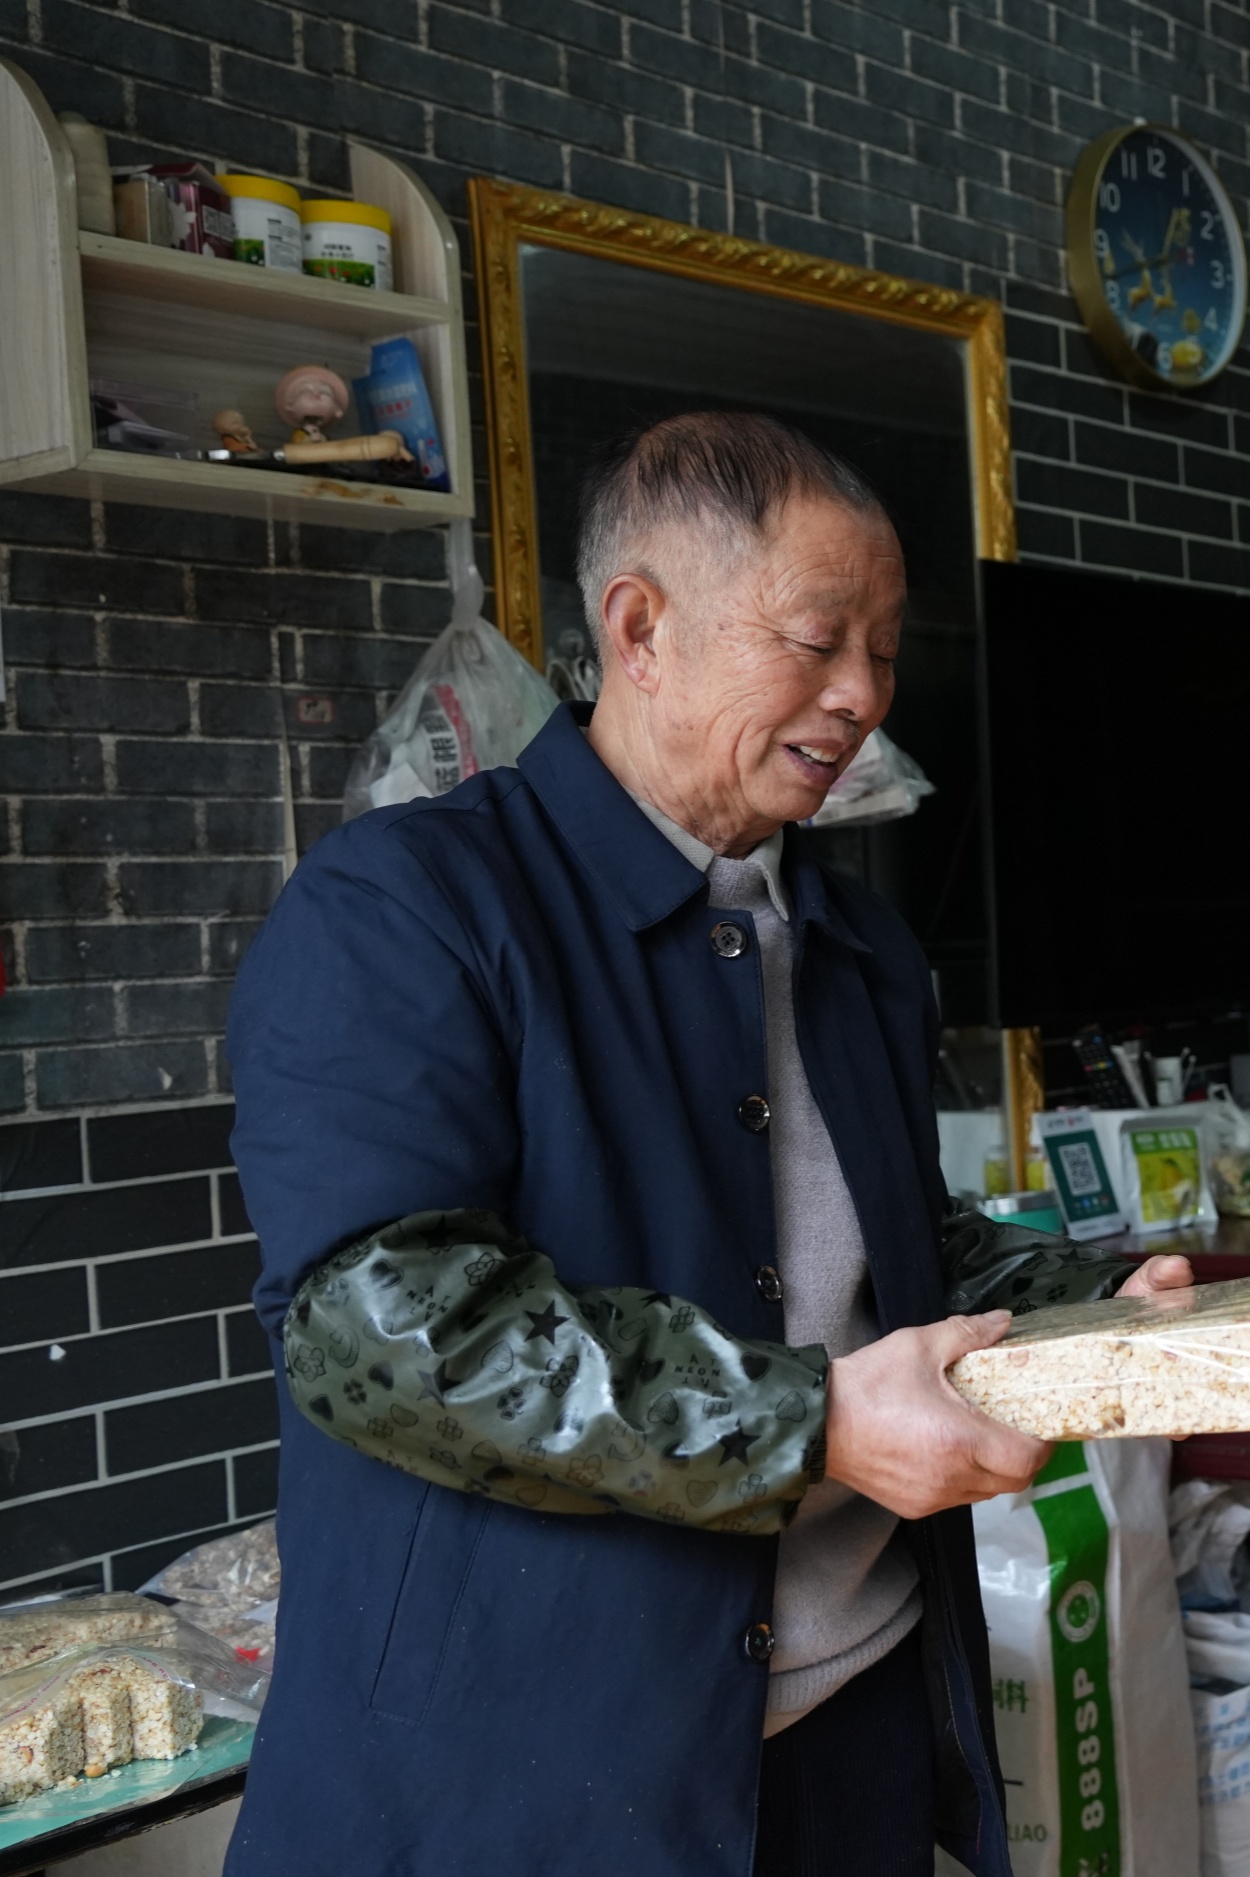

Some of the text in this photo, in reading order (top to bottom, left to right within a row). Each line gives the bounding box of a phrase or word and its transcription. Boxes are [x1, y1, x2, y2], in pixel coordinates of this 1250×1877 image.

[1120, 148, 1137, 181] 11
[1147, 145, 1167, 179] 12
[1099, 181, 1121, 214] 10
[1181, 167, 1190, 198] 1
[1200, 210, 1214, 241] 2
[1094, 227, 1111, 258] 9
[1209, 259, 1225, 290] 3
[1105, 279, 1122, 311] 8
[1203, 306, 1219, 332] 4
[1156, 341, 1174, 371] 6
[674, 1364, 721, 1377] NEON
[1073, 1667, 1106, 1832] 888SP
